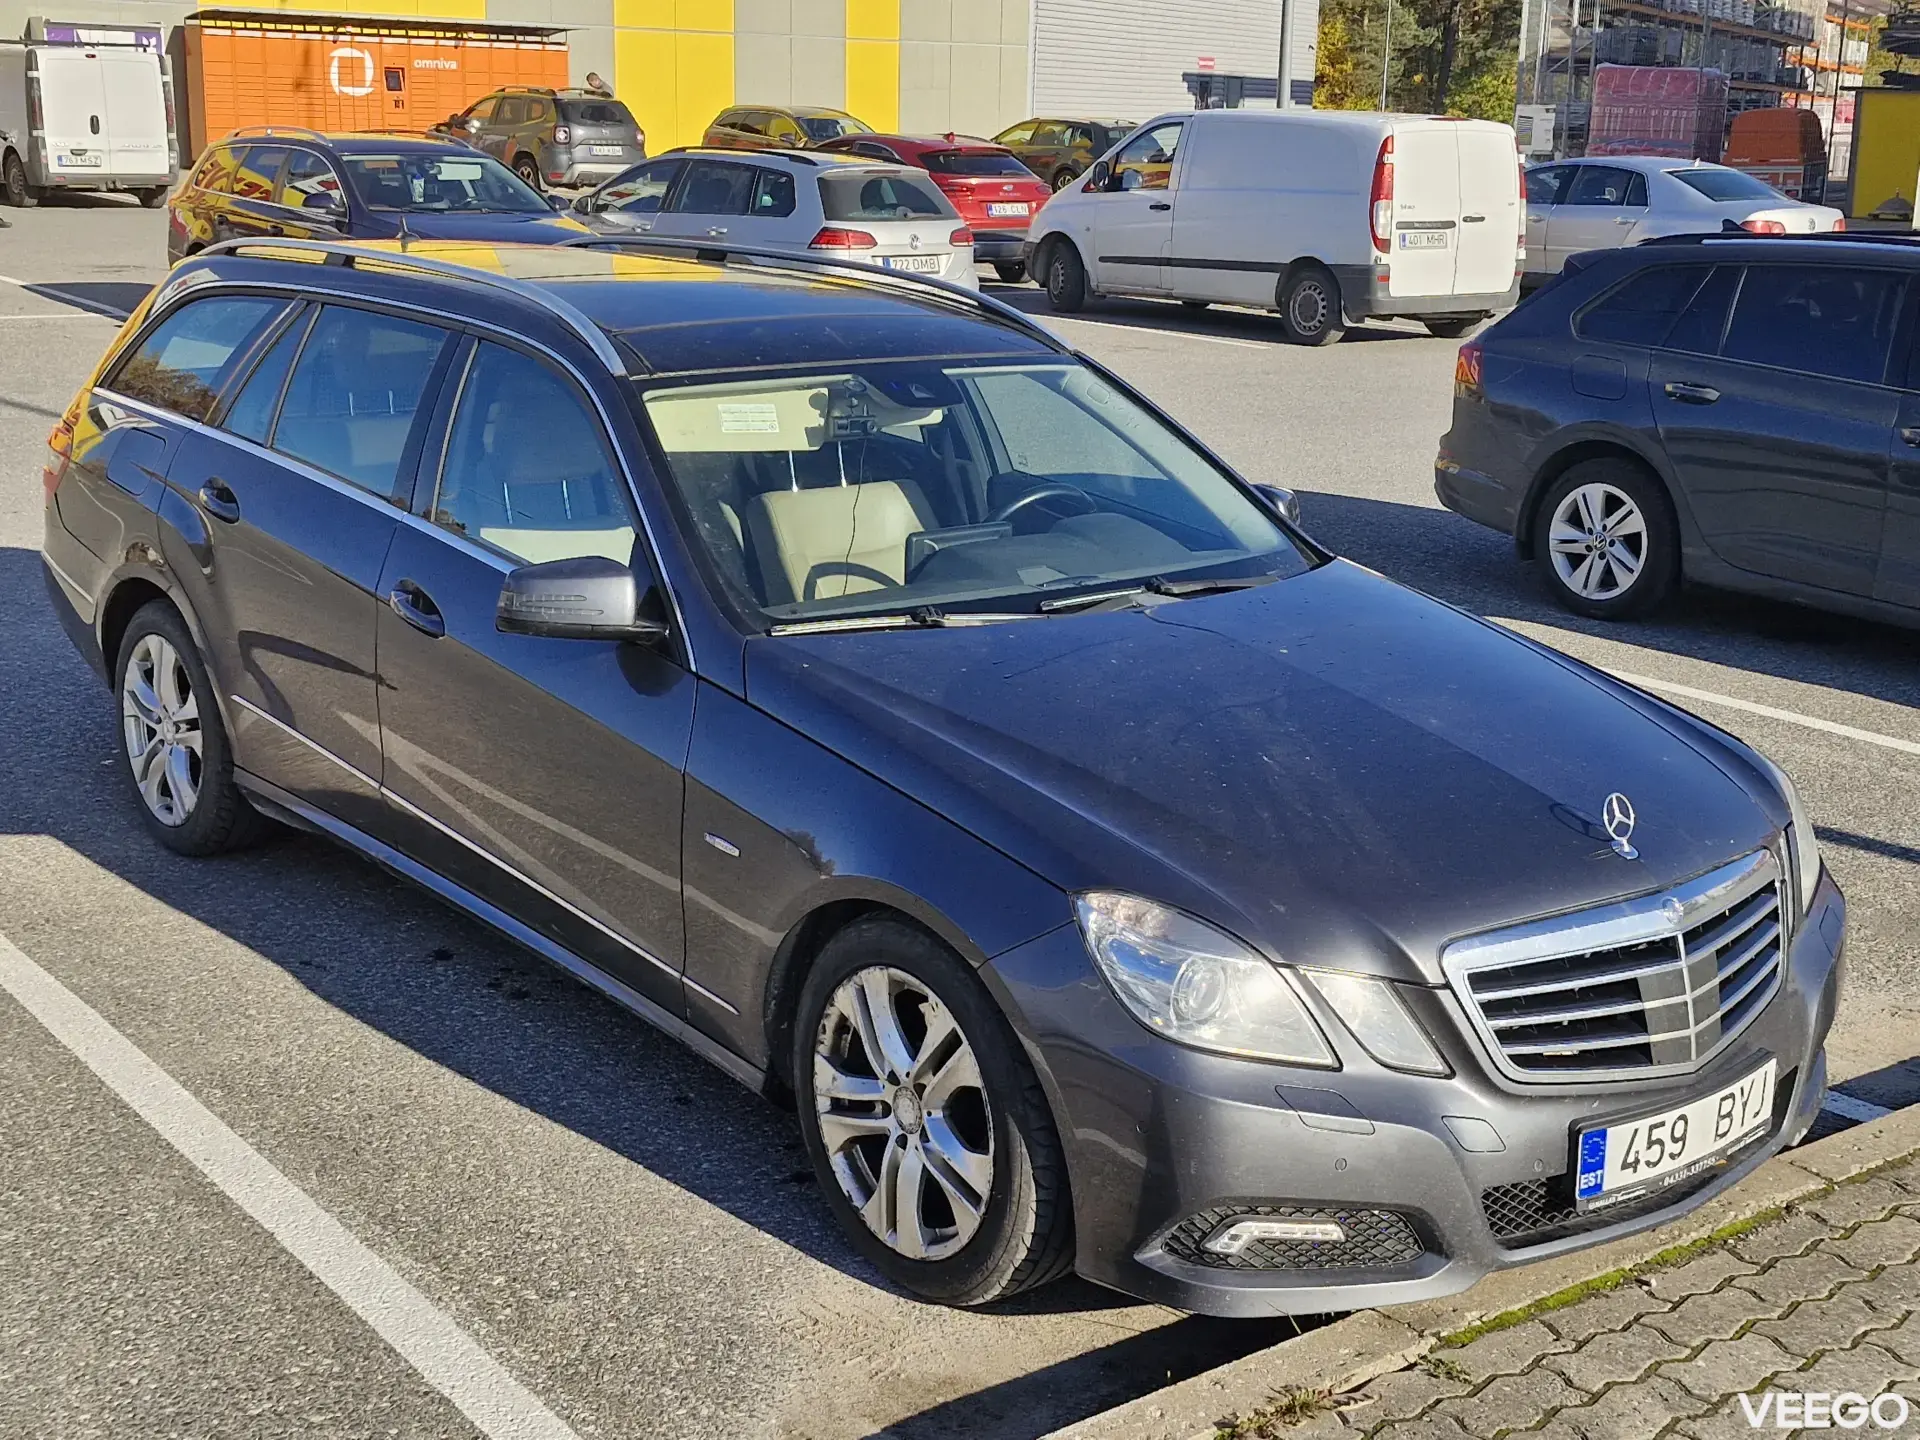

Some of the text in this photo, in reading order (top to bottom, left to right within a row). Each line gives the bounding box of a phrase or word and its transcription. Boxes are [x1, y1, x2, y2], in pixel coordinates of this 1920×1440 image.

[413, 57, 457, 70] omniva
[1426, 234, 1445, 245] MHR
[892, 259, 911, 270] 722
[1620, 1113, 1689, 1175] 459
[1713, 1070, 1769, 1143] BYJ
[1580, 1169, 1604, 1190] EST
